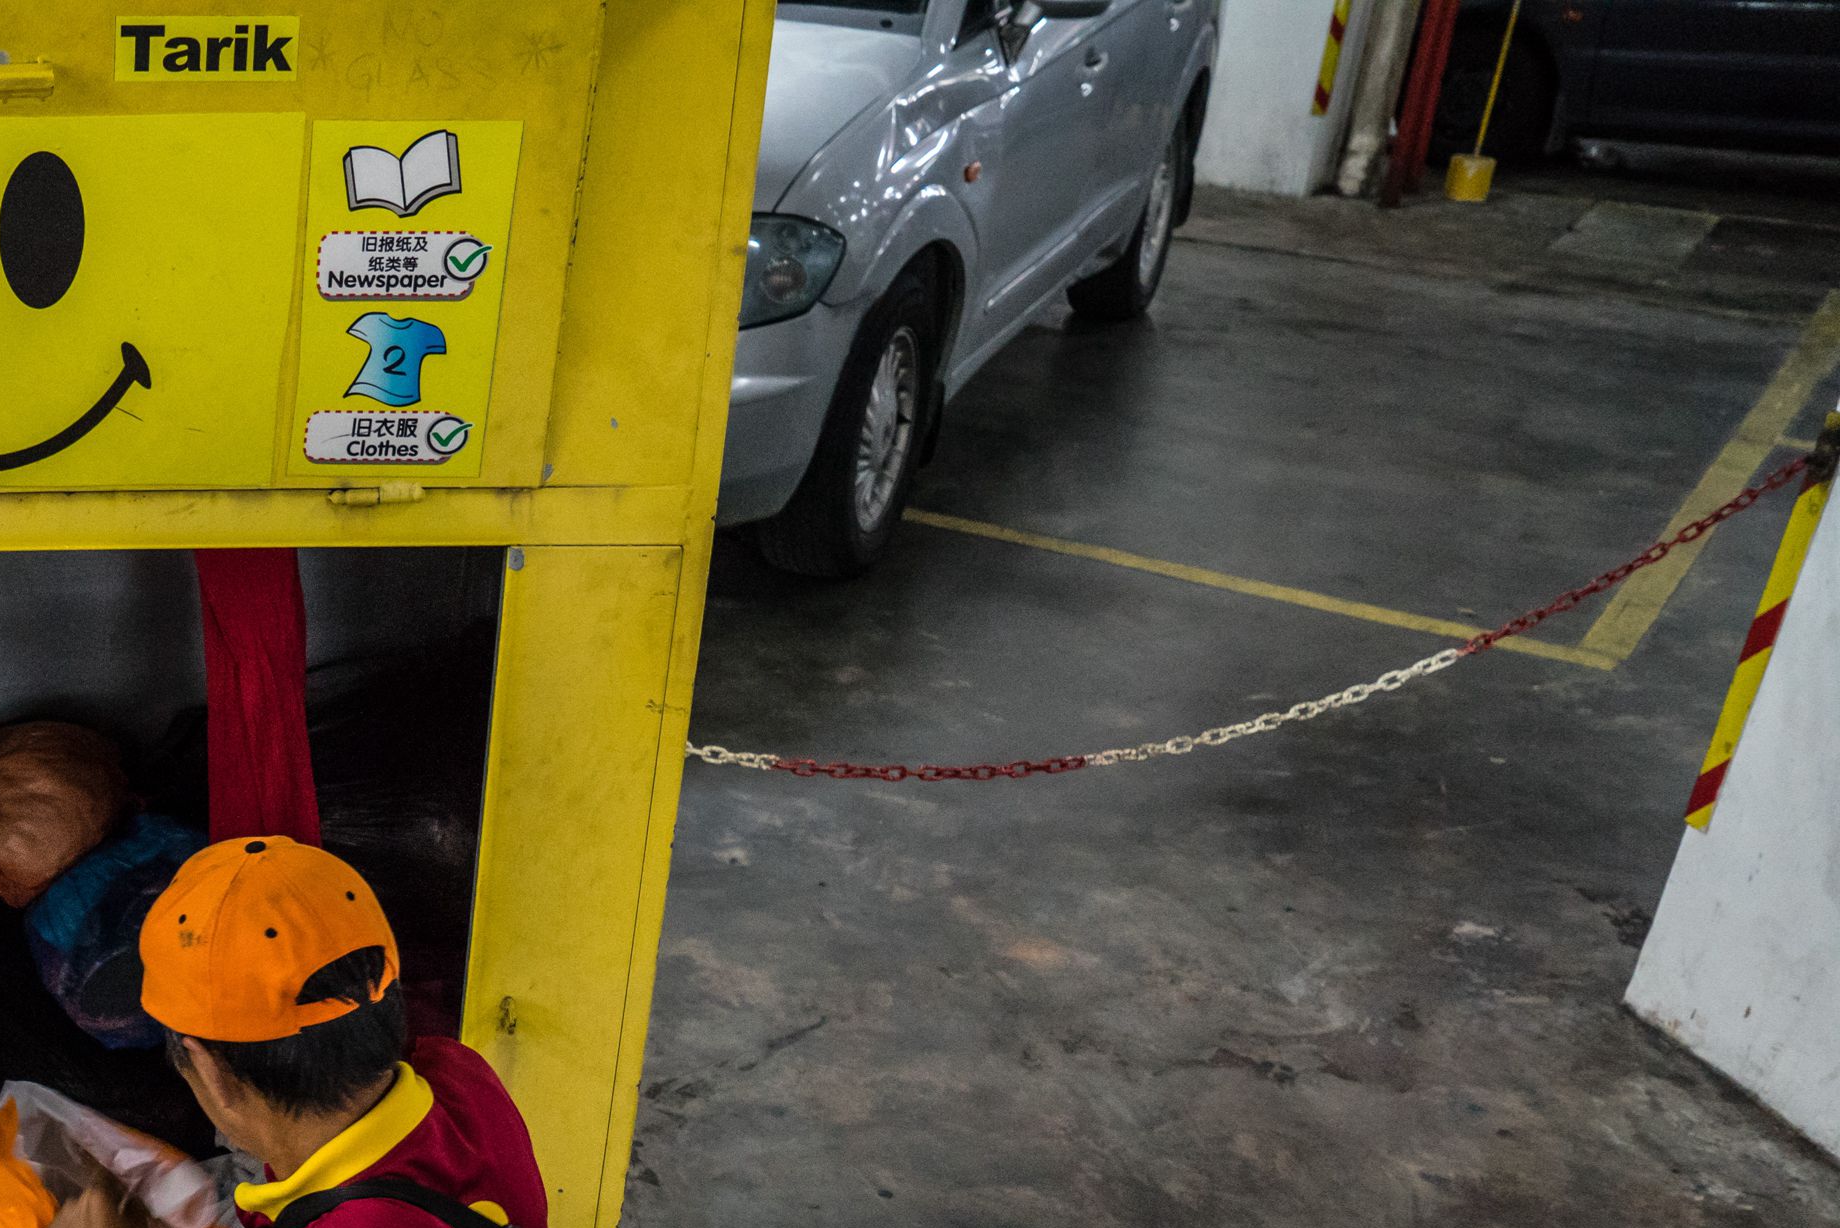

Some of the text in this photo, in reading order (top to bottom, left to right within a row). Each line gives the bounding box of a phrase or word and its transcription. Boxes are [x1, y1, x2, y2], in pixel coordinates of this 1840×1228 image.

[120, 24, 293, 73] Tarik
[361, 236, 428, 253] 旧报纸及
[367, 256, 419, 272] 纸类等
[327, 270, 448, 292] Newspaper
[351, 417, 419, 438] 旧衣服
[346, 440, 419, 457] Clothes
